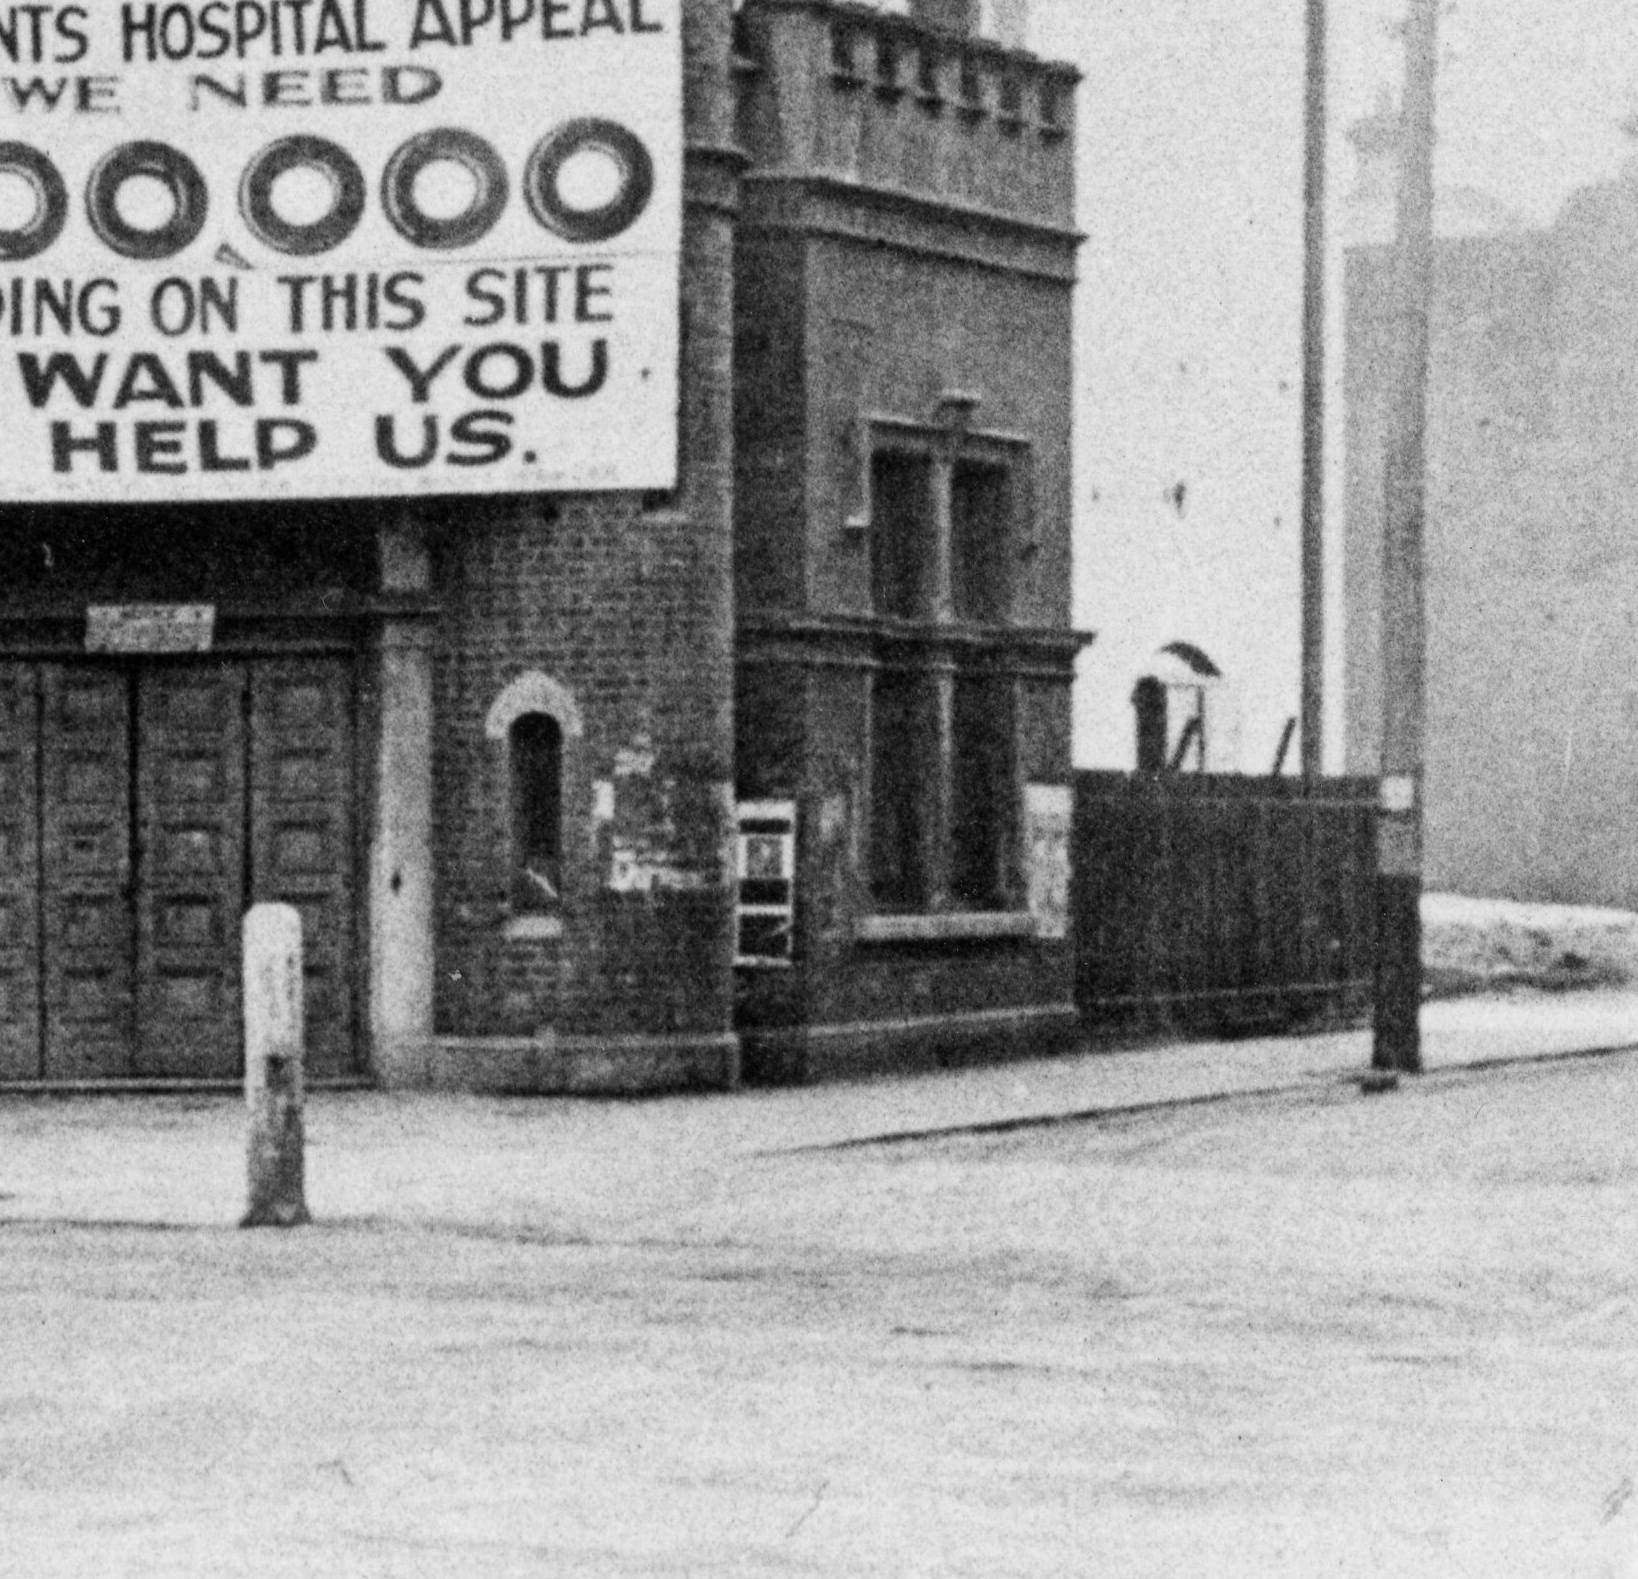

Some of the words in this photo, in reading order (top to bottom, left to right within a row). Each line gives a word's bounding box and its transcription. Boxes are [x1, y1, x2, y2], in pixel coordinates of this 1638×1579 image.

[0, 74, 123, 114] WE
[185, 64, 445, 113] NEED
[149, 275, 239, 338] ON
[275, 270, 427, 335] THIS
[463, 263, 616, 327] SITE
[15, 348, 320, 410] WANT
[381, 337, 609, 404] YOU
[46, 416, 318, 476] HELP
[374, 409, 537, 470] US.
